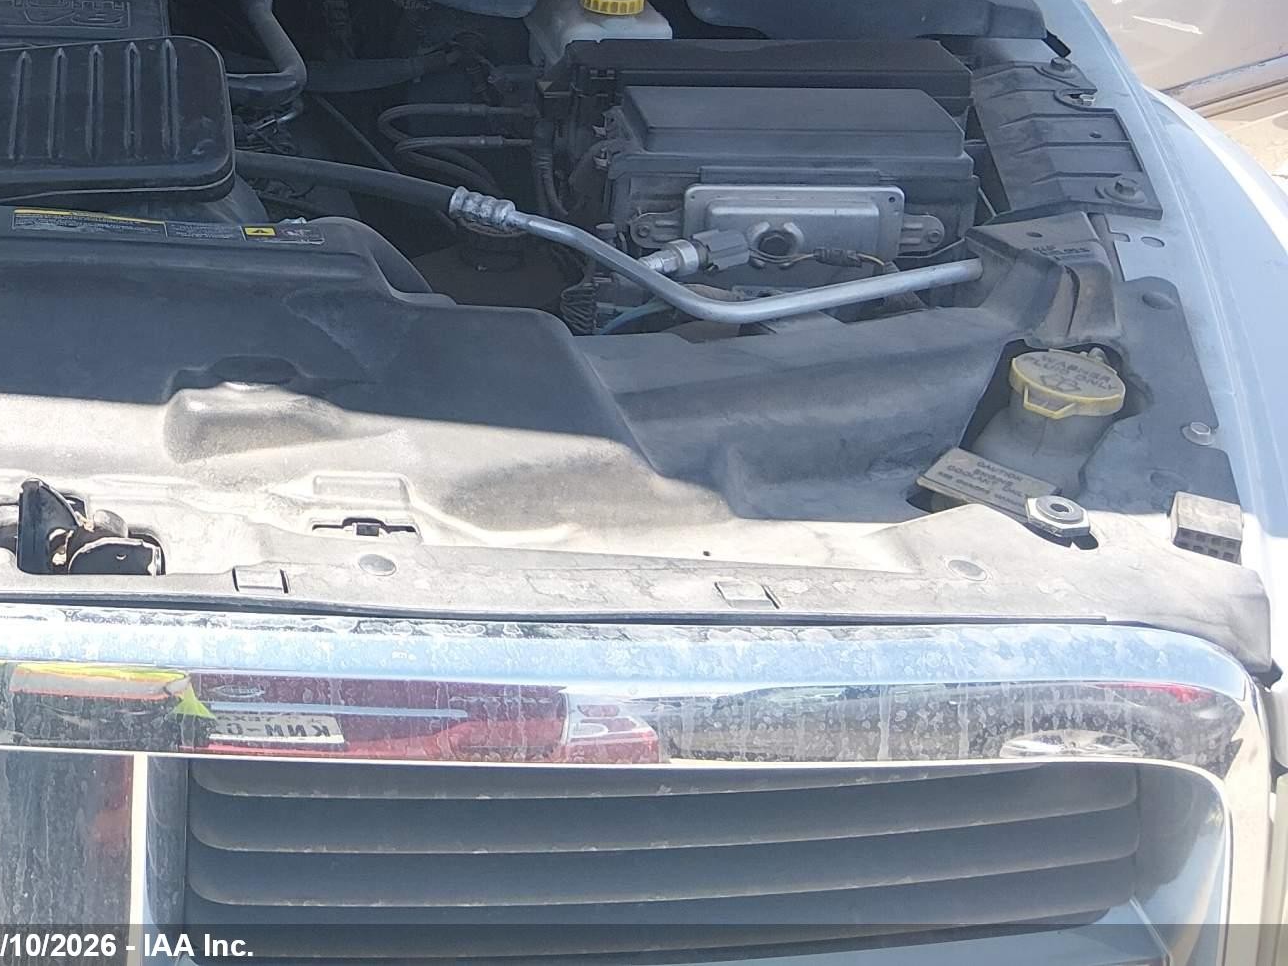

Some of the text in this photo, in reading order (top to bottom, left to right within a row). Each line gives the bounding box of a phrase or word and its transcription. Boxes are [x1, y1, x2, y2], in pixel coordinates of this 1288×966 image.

[1075, 373, 1118, 391] ONLY
[947, 464, 1000, 485] COOLANT
[976, 460, 1025, 482] CAUTION
